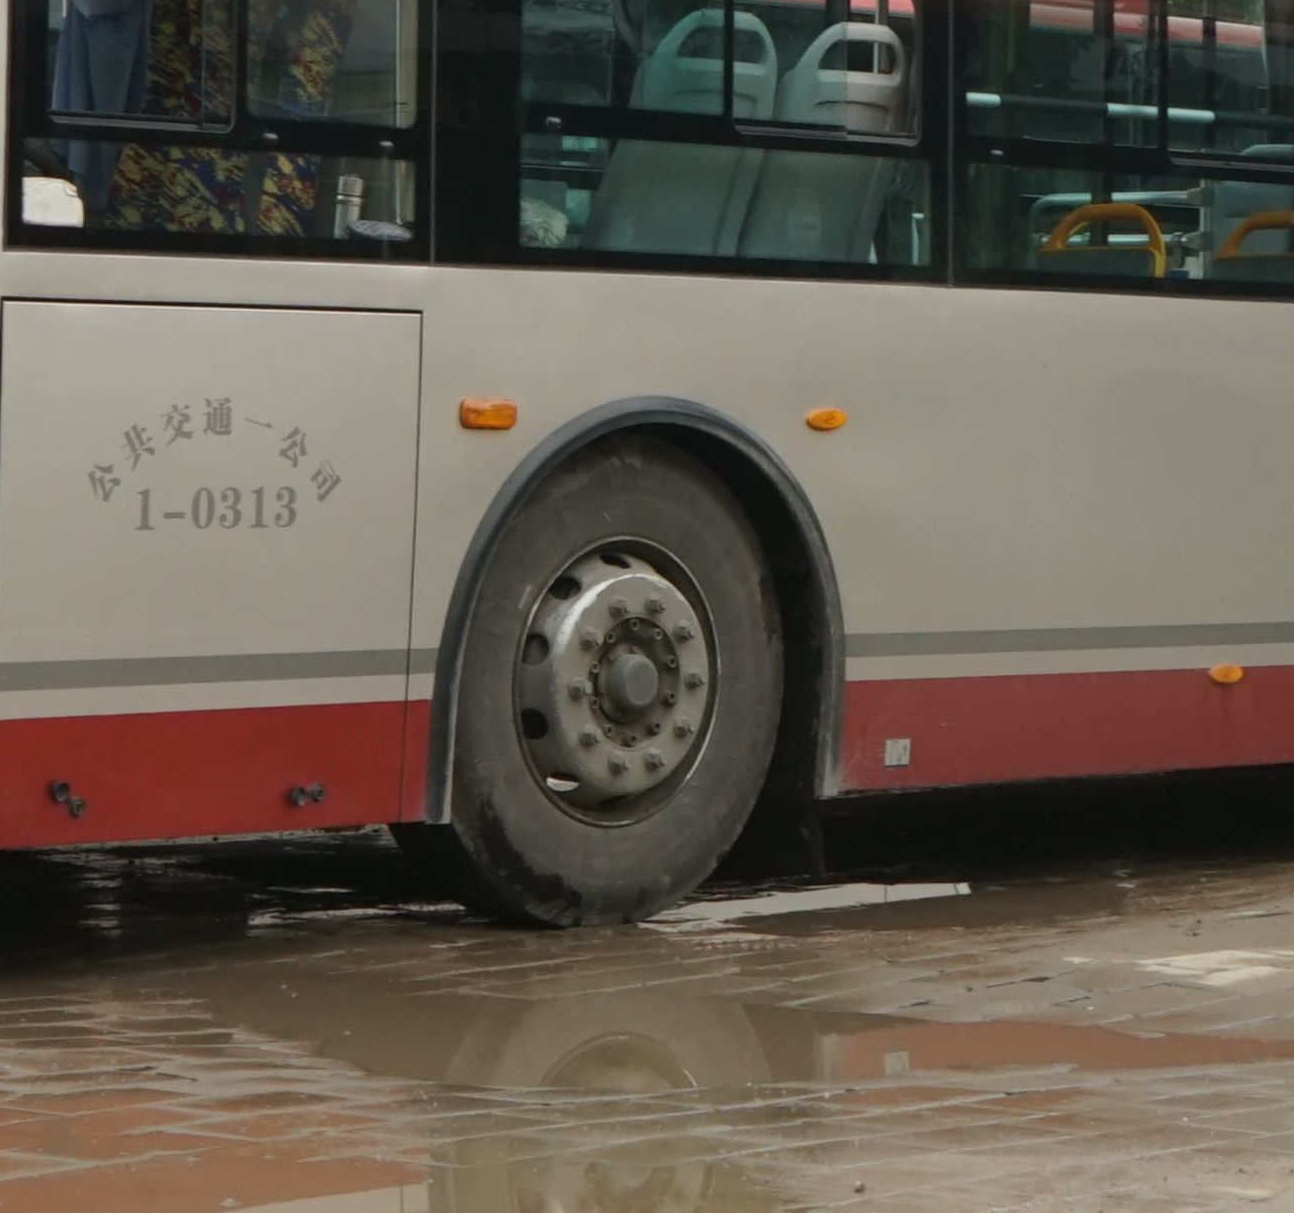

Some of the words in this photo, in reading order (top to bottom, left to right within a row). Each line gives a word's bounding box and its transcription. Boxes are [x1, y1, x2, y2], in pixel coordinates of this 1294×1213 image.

[87, 397, 342, 502] 公共交通一公司
[134, 486, 298, 531] 1-0313
